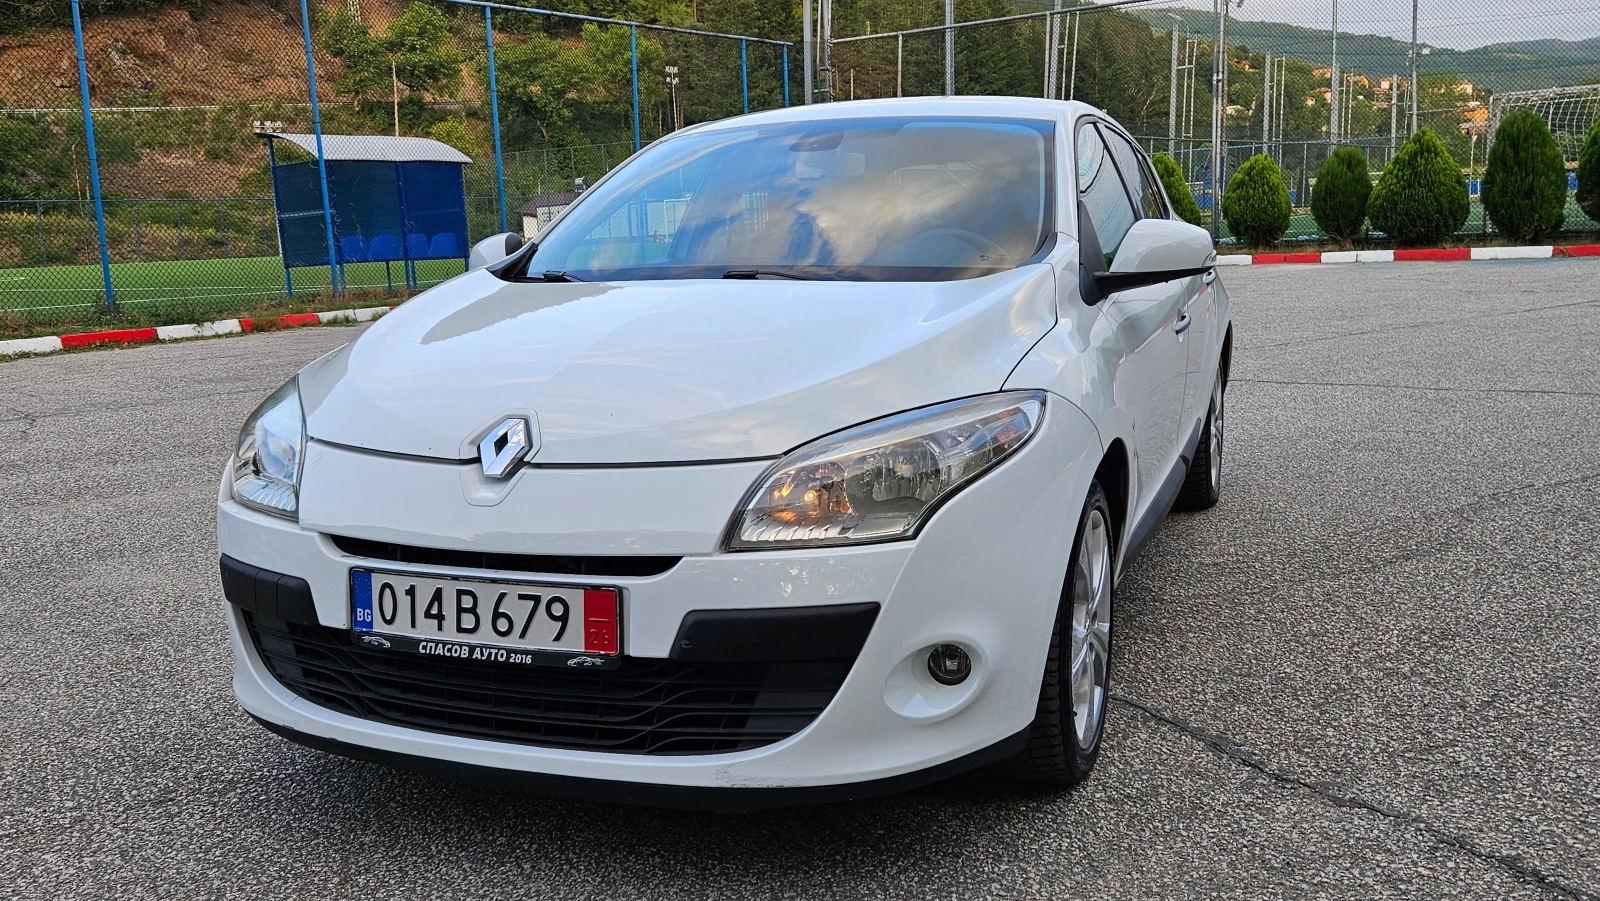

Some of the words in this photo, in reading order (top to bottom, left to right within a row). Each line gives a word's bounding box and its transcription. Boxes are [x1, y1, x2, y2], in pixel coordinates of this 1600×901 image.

[356, 607, 372, 623] BG
[588, 630, 611, 646] 26
[418, 641, 469, 658] СПАСОВ
[472, 646, 507, 662] АУТО
[509, 653, 532, 664] 2016
